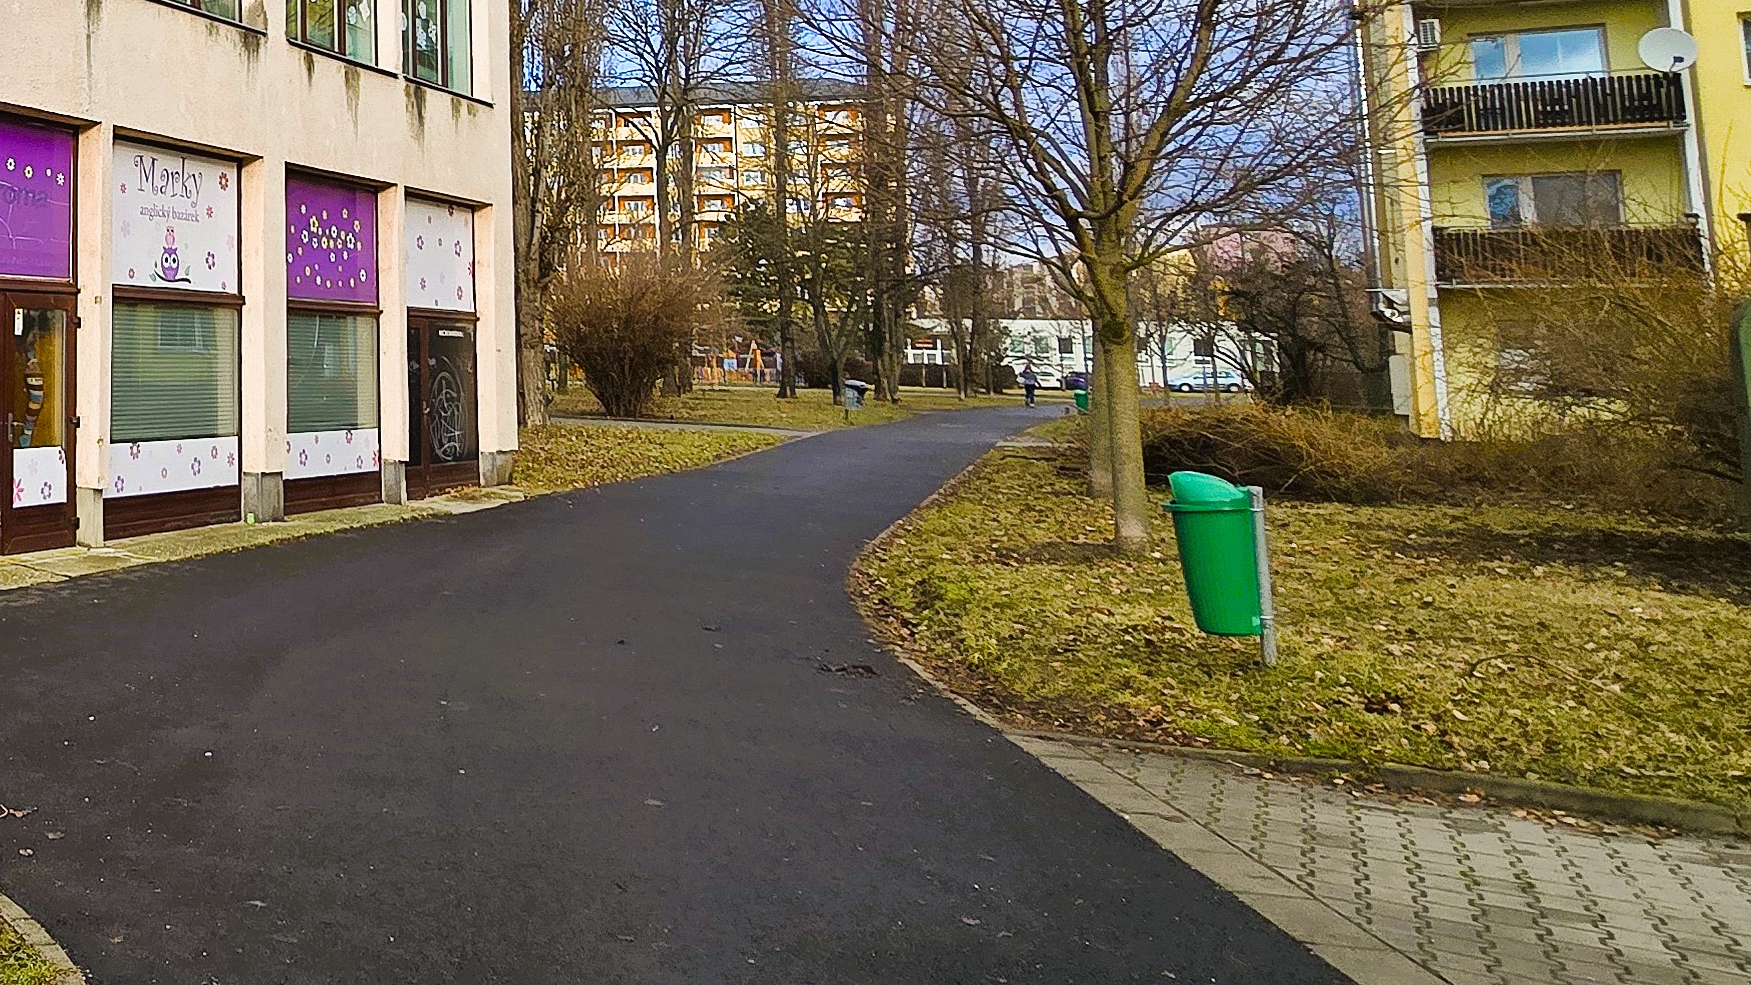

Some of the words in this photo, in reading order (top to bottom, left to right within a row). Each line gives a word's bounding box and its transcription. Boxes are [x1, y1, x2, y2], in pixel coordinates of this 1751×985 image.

[133, 154, 203, 208] Marky
[139, 203, 171, 222] anglický
[171, 205, 200, 223] bazárek
